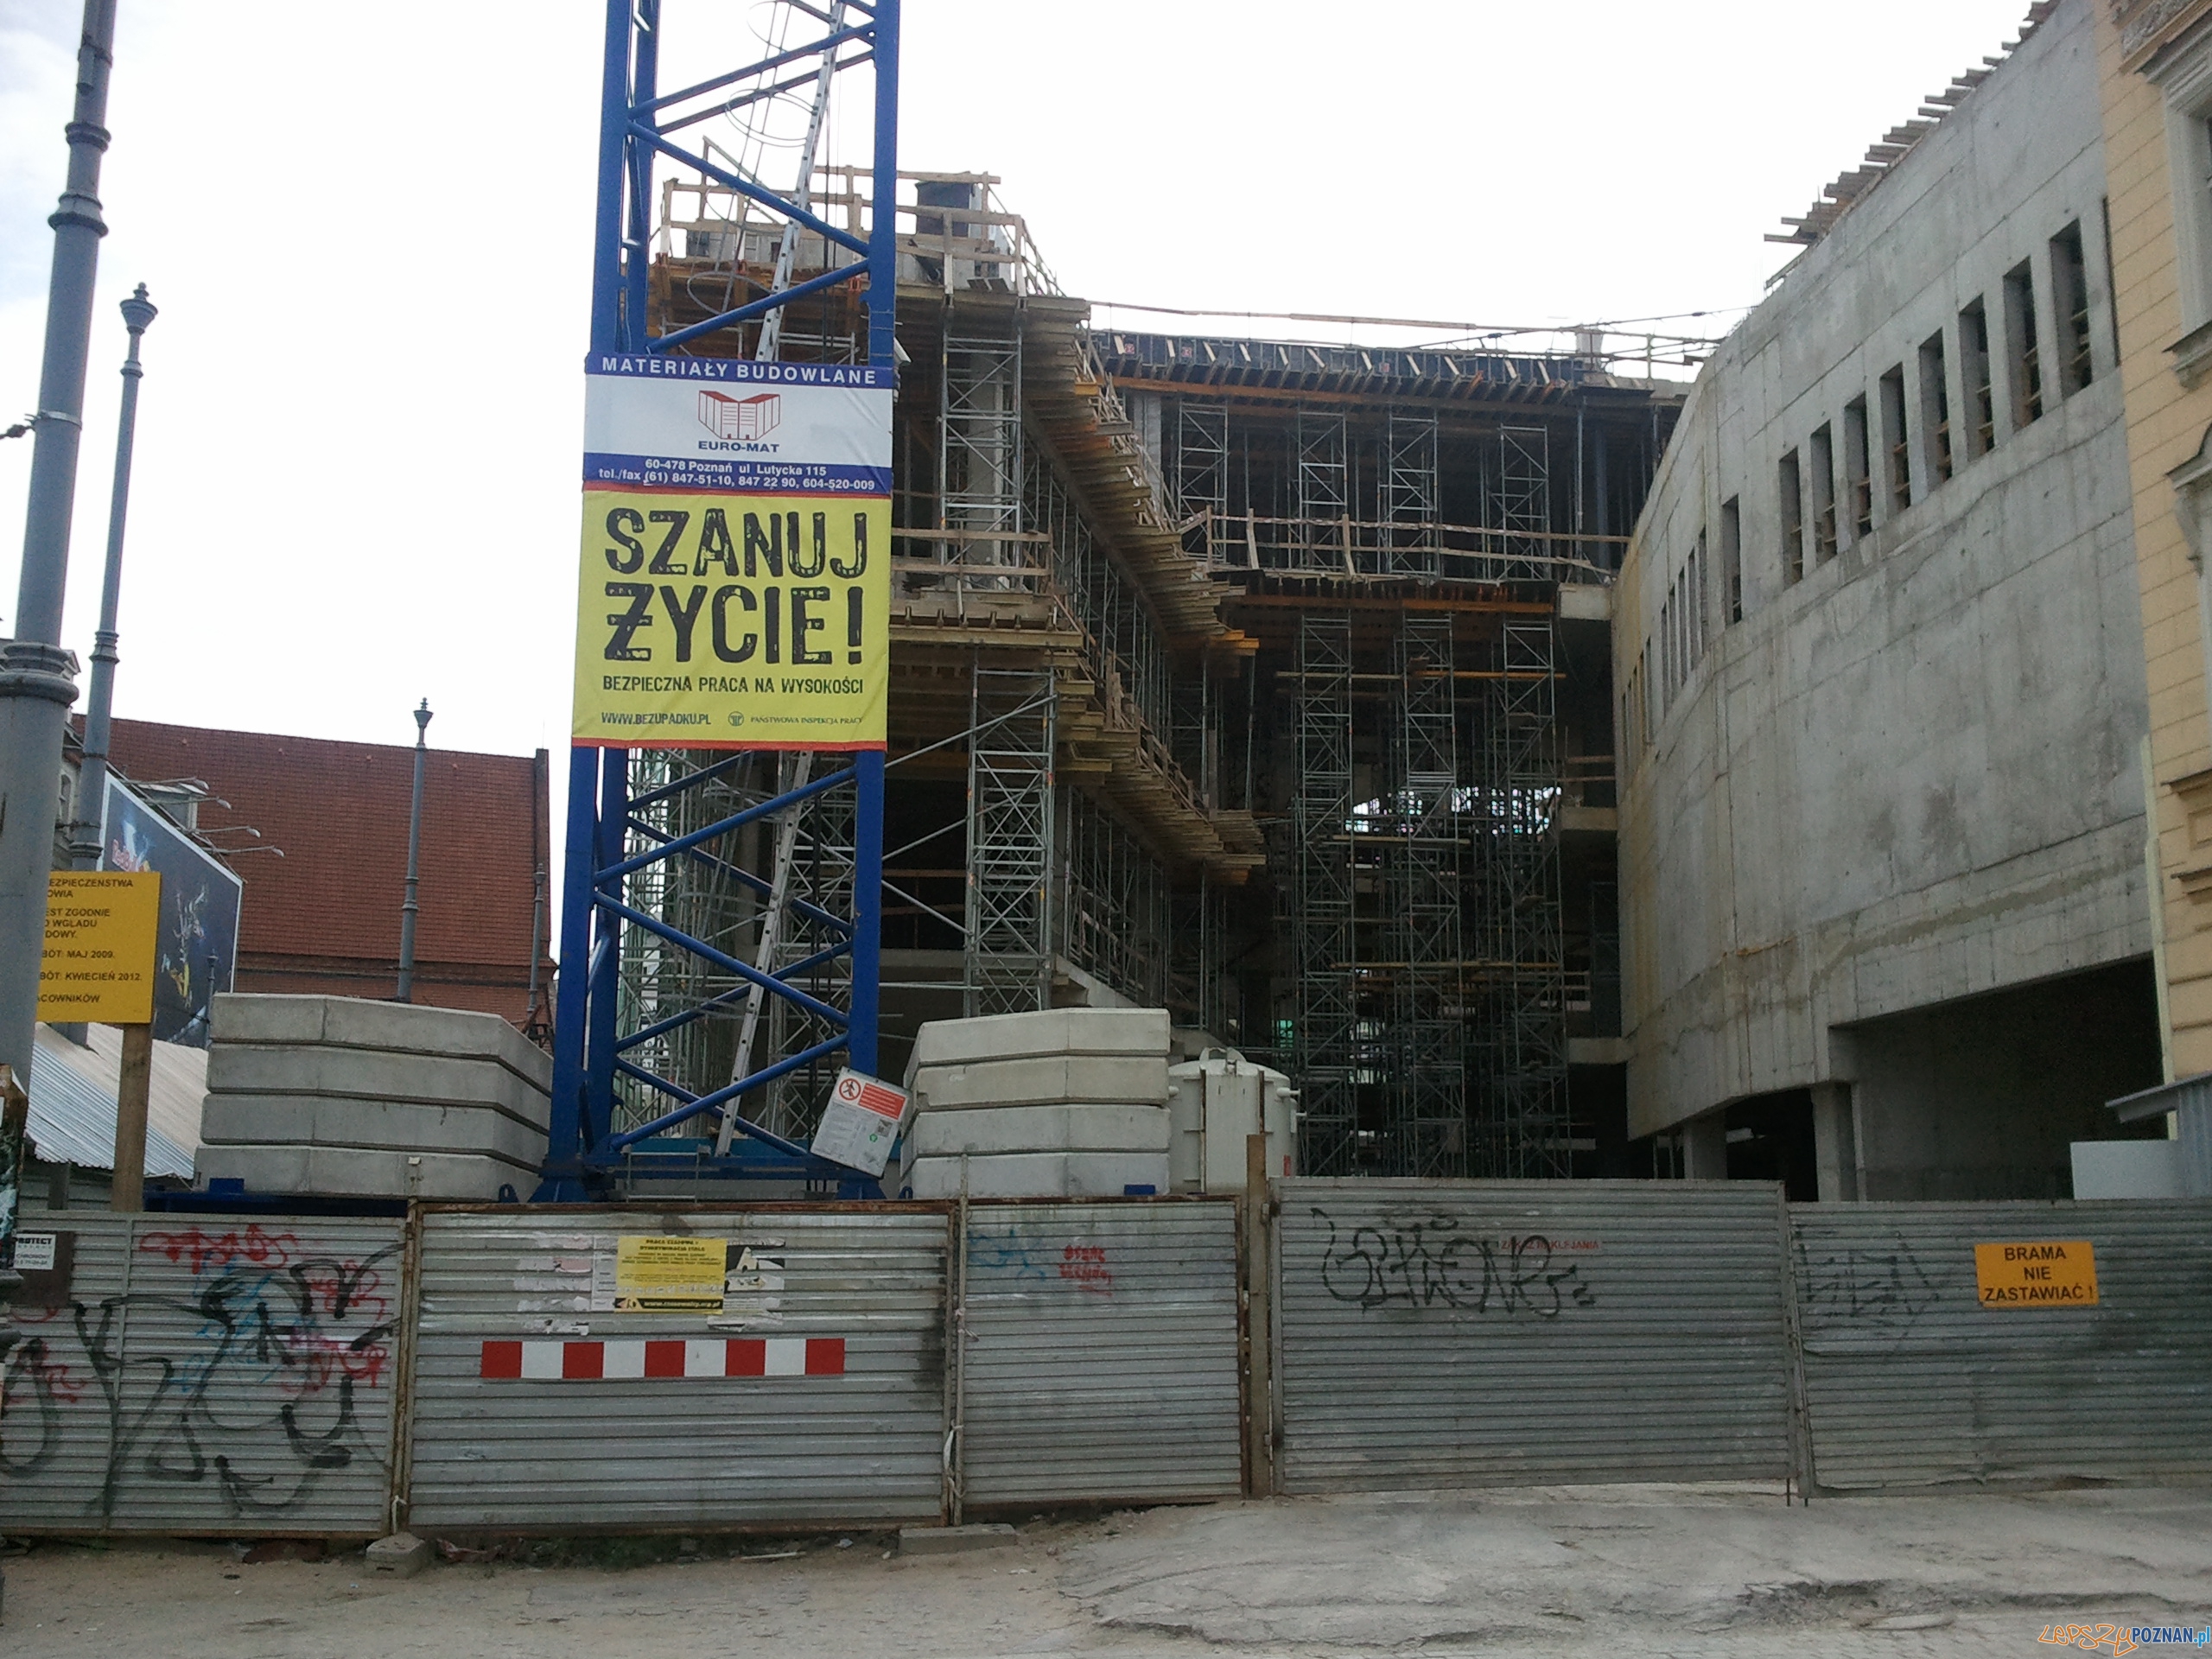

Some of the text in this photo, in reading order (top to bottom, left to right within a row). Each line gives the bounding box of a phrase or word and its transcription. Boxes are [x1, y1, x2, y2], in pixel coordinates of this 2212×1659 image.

[602, 357, 876, 385] MATERIAŁY BUDOWLANE
[698, 441, 780, 453] EURO-MAT
[645, 459, 827, 477] 60-478 Poznań ul Lutycka 115
[644, 471, 668, 484] (61)
[671, 473, 735, 487] 847-51-10,
[739, 476, 761, 486] 847
[763, 477, 779, 487] 22
[803, 479, 875, 490] 604-520-009
[605, 507, 868, 578] SZANUJ
[602, 676, 864, 695] BEZPIECZNA PRACA NA WYSOKOŚCI
[601, 712, 711, 725] WWW.BEZUPADKU.PL
[65, 908, 111, 917] ZGODNIE
[65, 970, 116, 981] KWIECIEŃ
[2004, 1246, 2067, 1261] BRAMA
[2023, 1266, 2052, 1281] NIE
[1984, 1283, 2084, 1302] ZASTAWIAĆ
